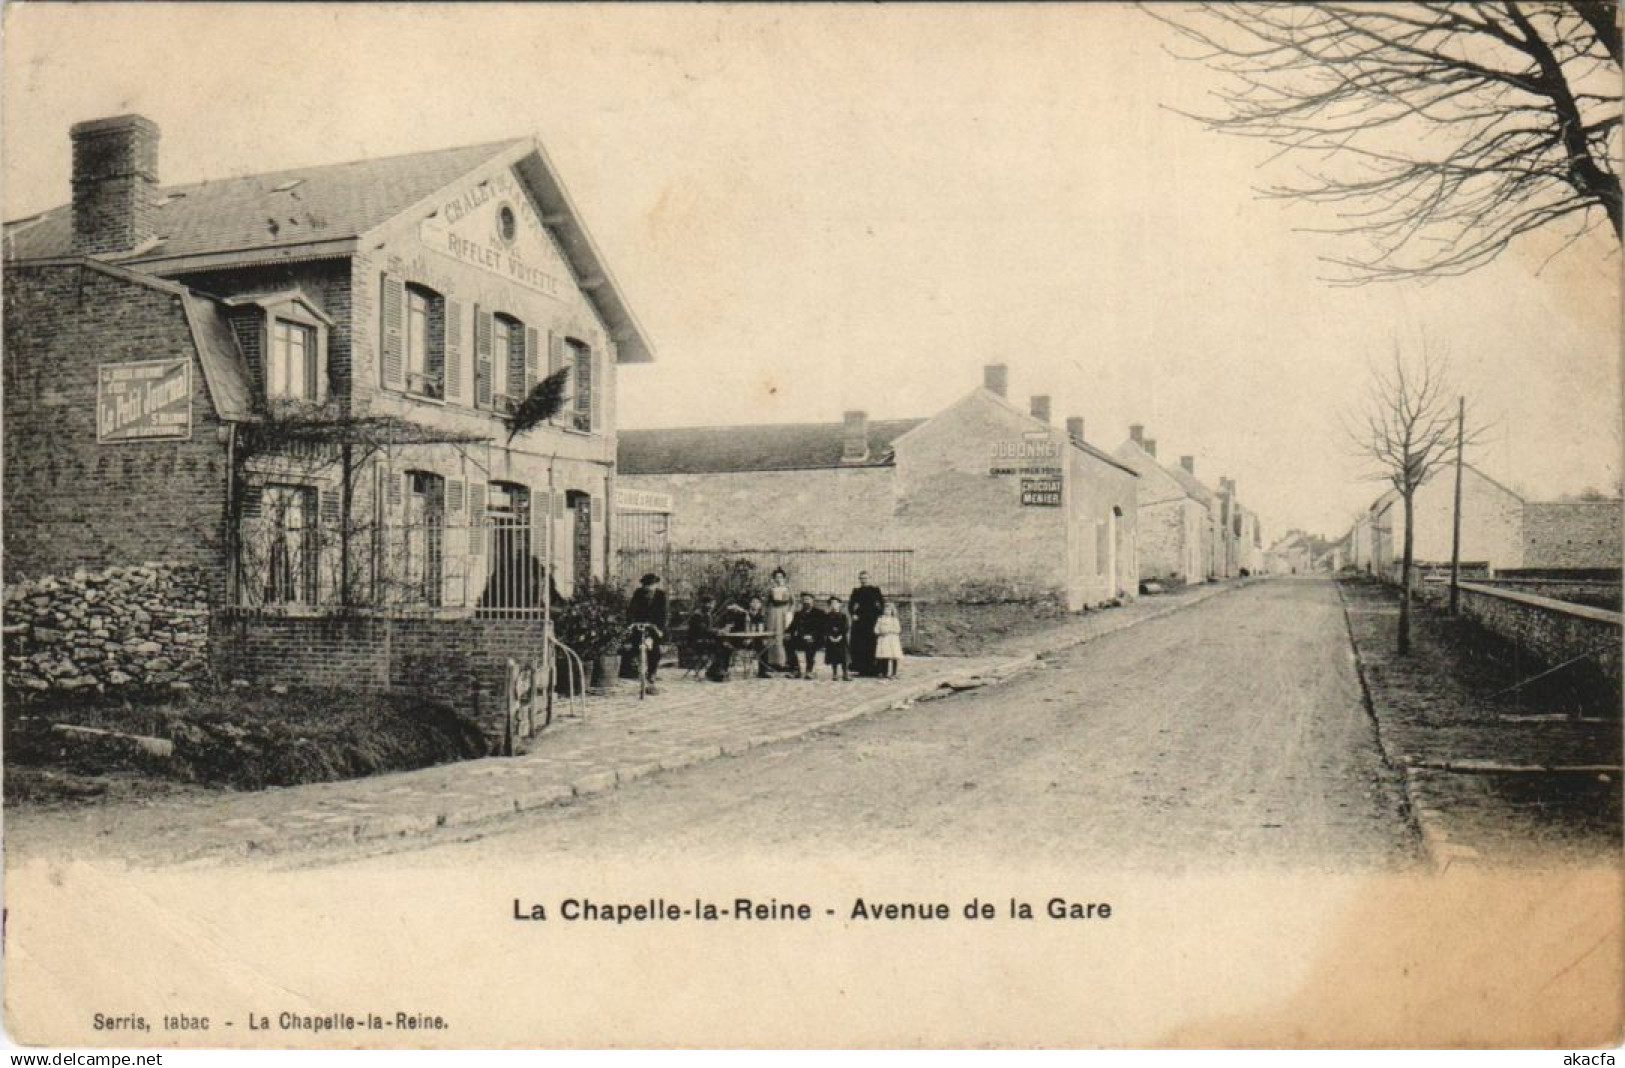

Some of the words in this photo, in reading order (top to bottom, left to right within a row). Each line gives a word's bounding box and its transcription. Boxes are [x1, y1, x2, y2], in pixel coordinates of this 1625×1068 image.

[448, 232, 501, 270] RIFFLET
[101, 403, 114, 436] Le
[116, 386, 142, 430] Petit
[143, 362, 187, 415] Journal
[988, 442, 1063, 458] DUBONNET
[1022, 480, 1060, 492] CHOCOLAT
[1022, 493, 1059, 504] MENIER
